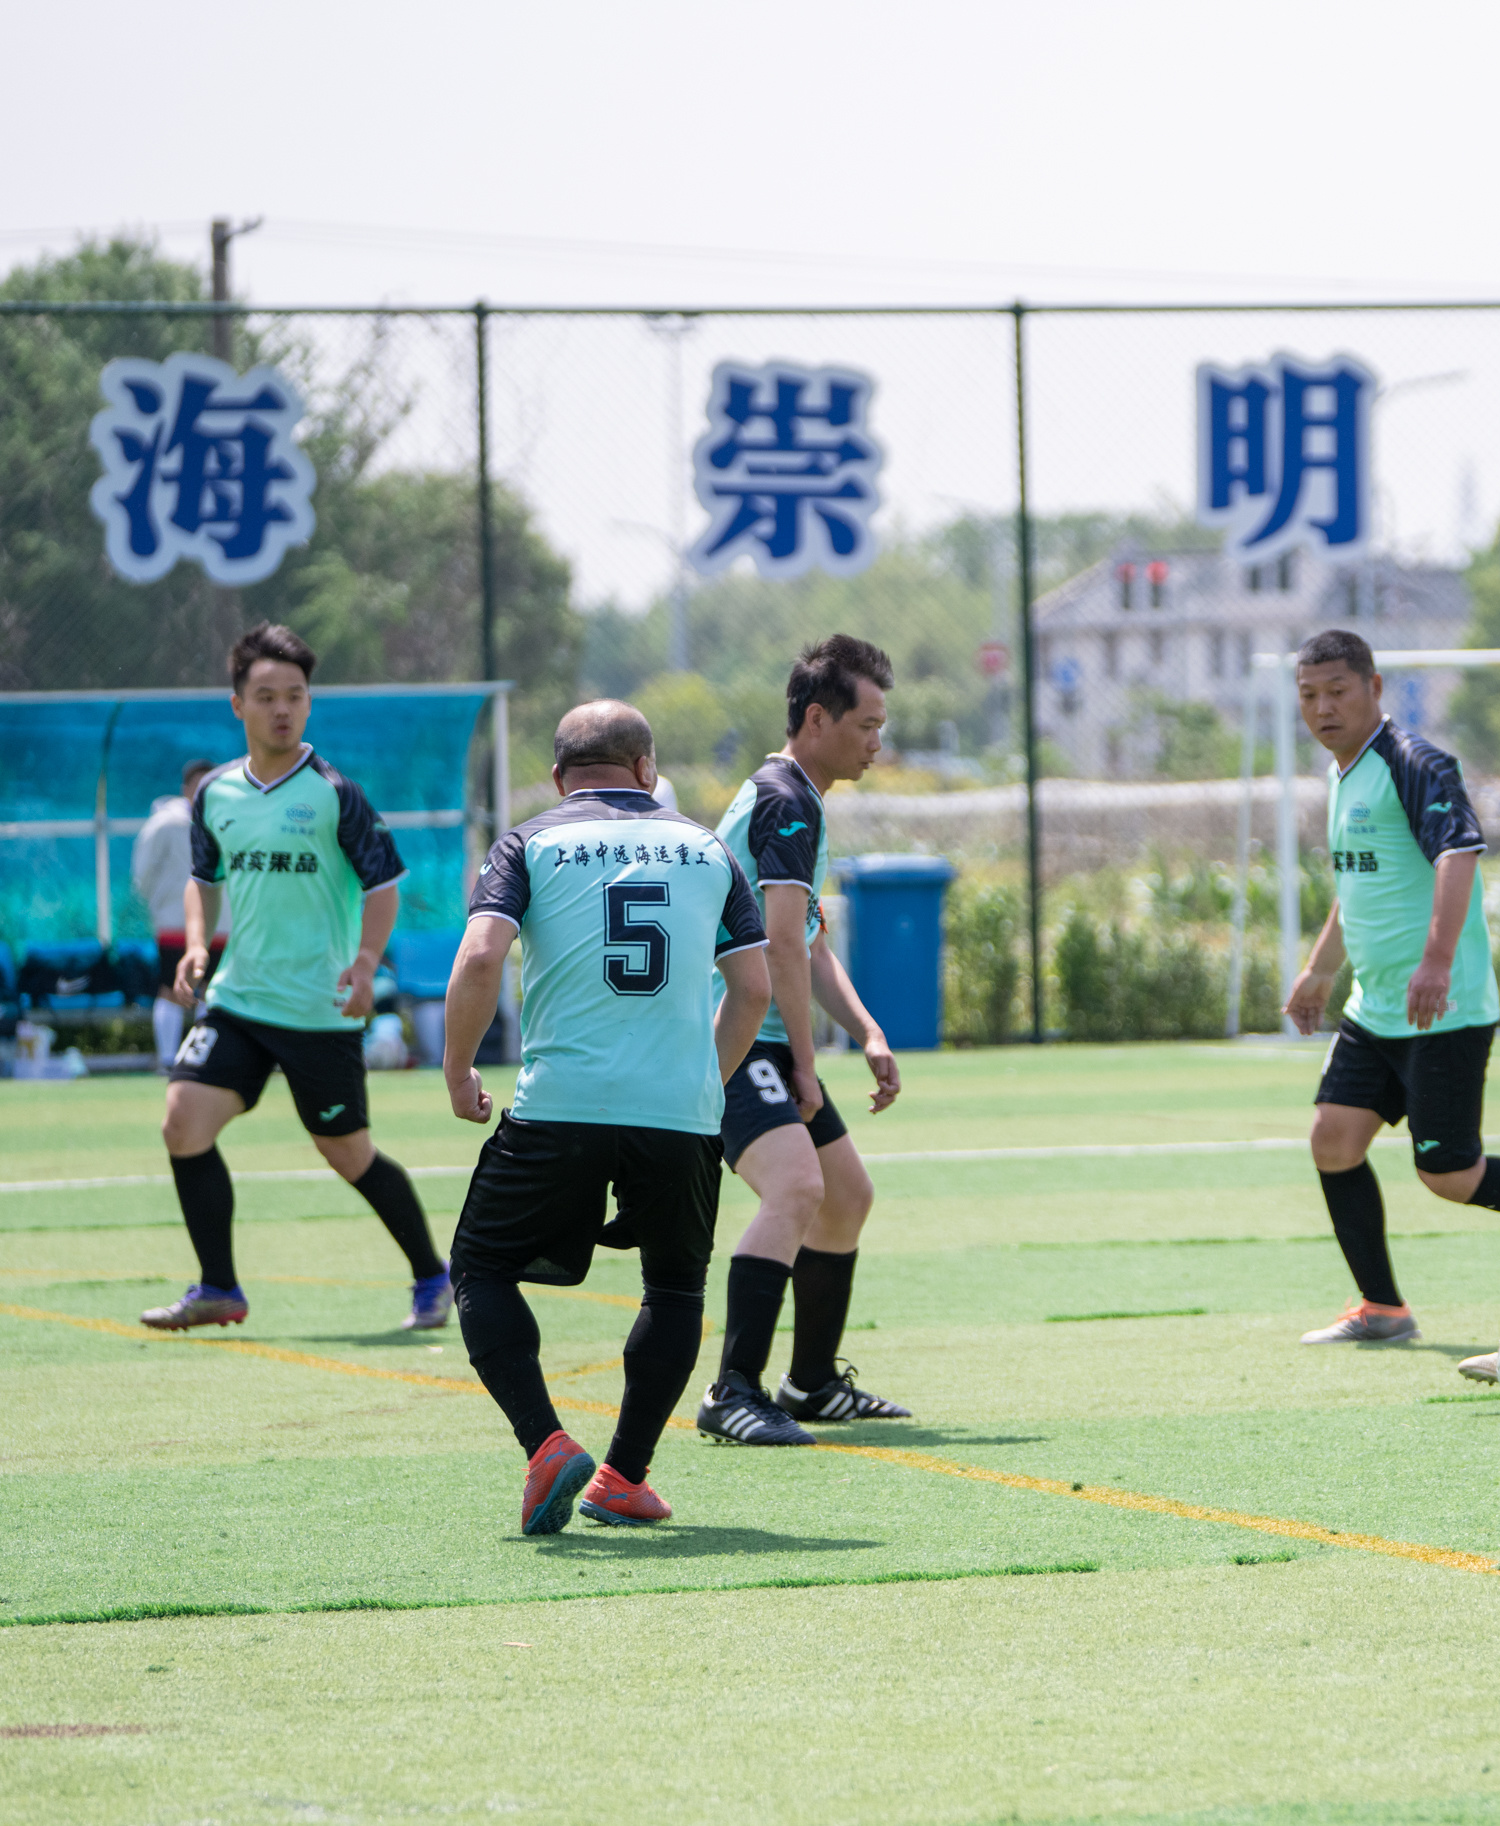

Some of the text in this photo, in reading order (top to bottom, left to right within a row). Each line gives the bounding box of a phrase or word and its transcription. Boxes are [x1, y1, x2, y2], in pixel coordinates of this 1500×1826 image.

[554, 840, 711, 868] 上海中远海运重工
[603, 881, 670, 997] 5
[747, 1058, 789, 1105] 9
